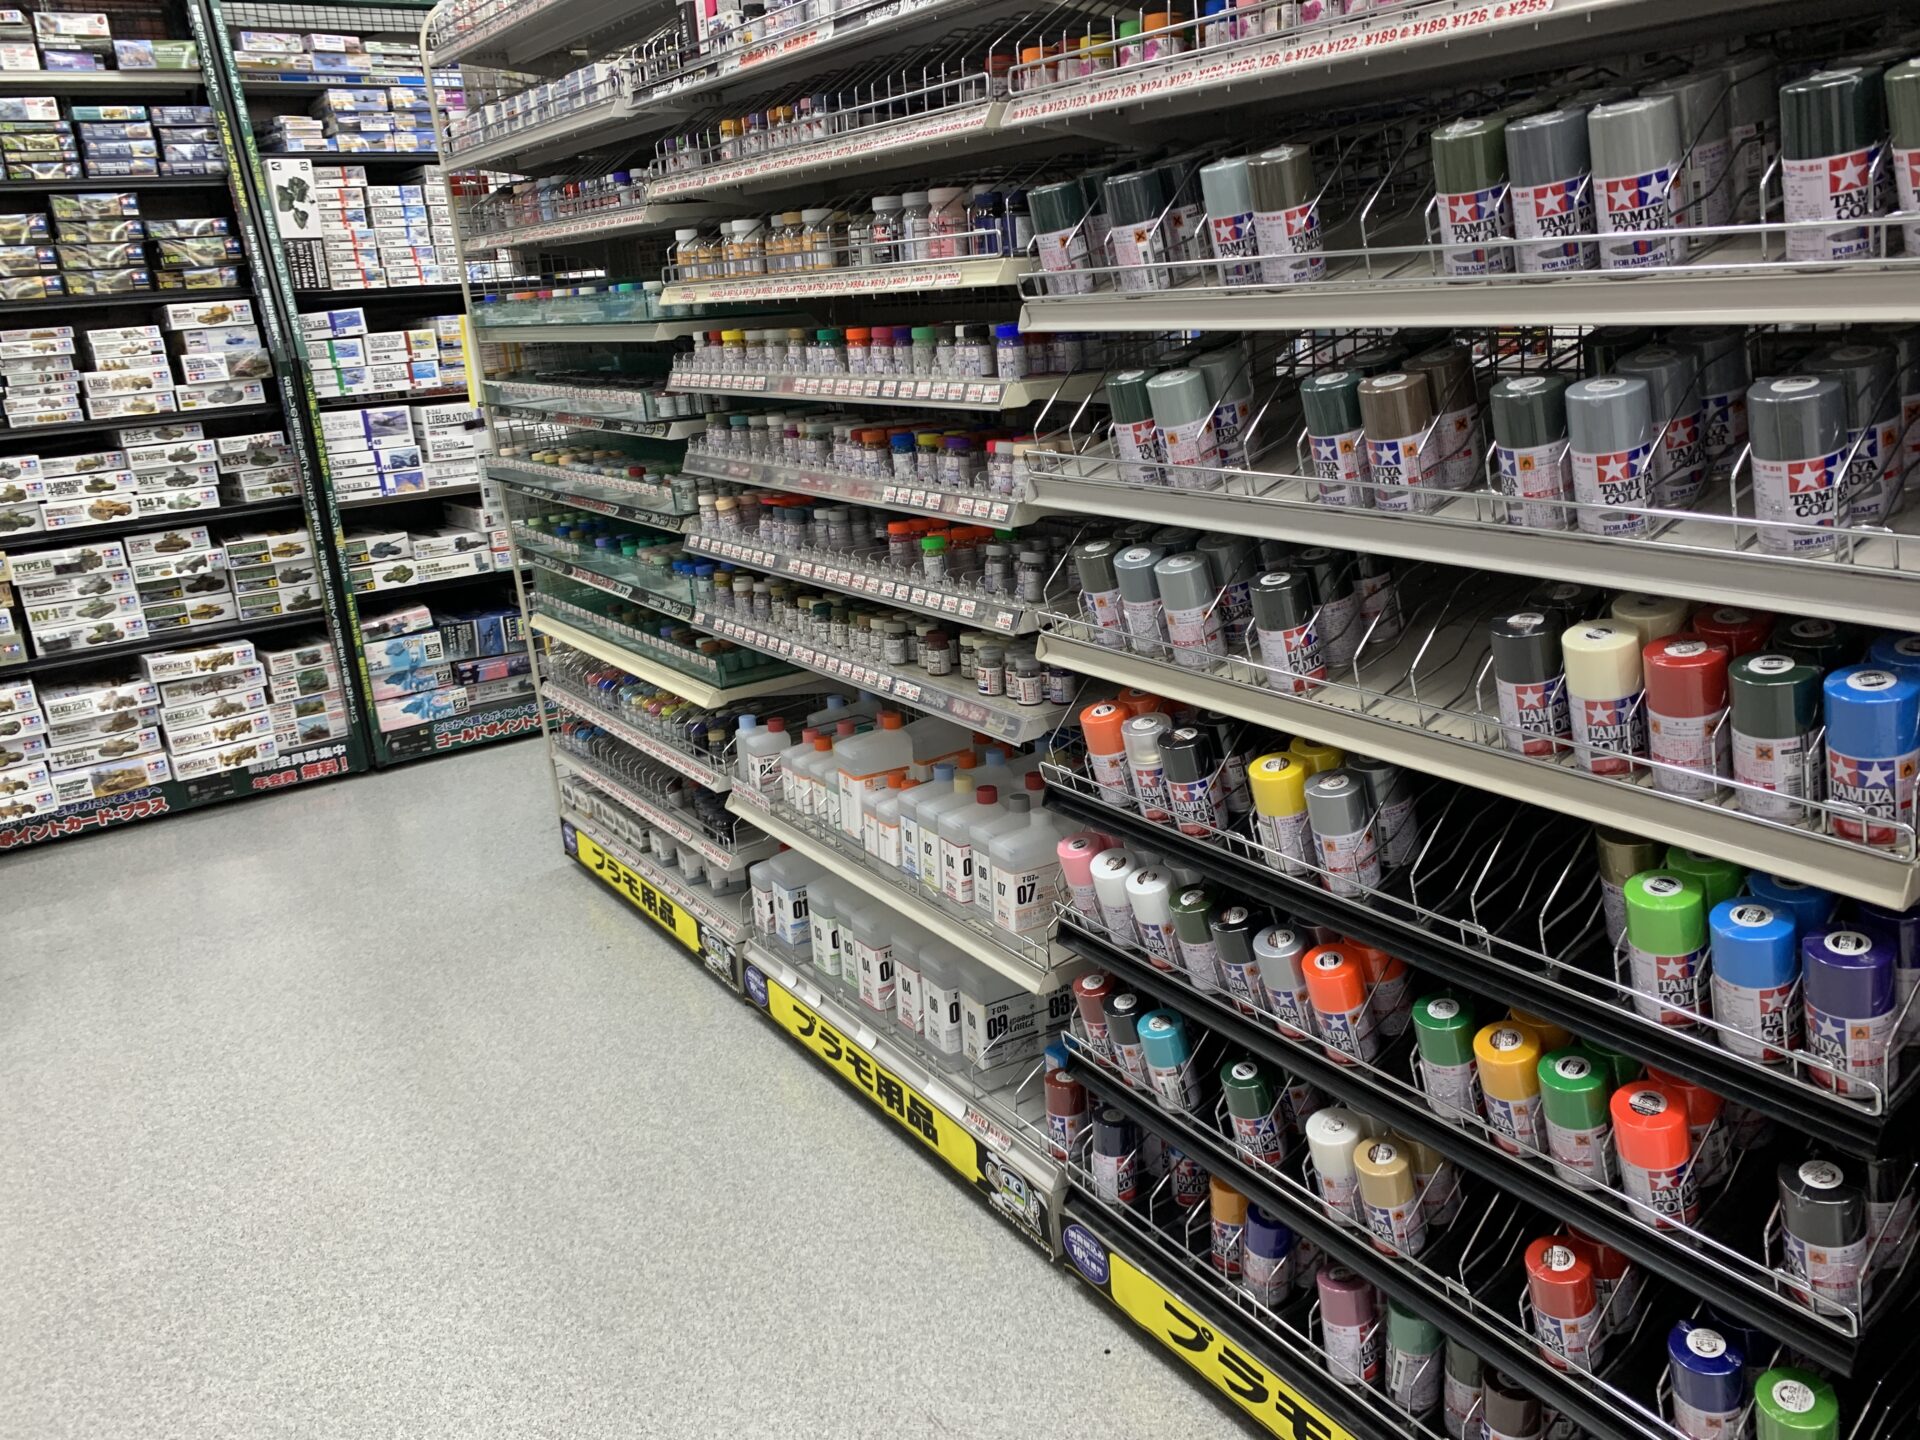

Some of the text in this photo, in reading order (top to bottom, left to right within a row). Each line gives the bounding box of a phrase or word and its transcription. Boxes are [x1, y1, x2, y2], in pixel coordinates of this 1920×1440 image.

[427, 411, 474, 424] LIBERATOR
[222, 455, 248, 467] R35
[330, 458, 357, 466] ANKER
[336, 482, 363, 491] ANKER
[13, 559, 52, 572] TYPE 16
[30, 608, 59, 623] KV-1
[440, 675, 453, 683] 27
[455, 700, 466, 709] 27
[252, 769, 298, 789] 年会費
[1831, 778, 1894, 804] TAMIYA
[905, 829, 913, 844] 01
[924, 843, 932, 856] 02
[946, 855, 955, 869] 04
[963, 858, 972, 876] 0
[978, 865, 987, 881] 06
[592, 848, 677, 932] プラモ用品
[997, 882, 1006, 896] 07
[1017, 883, 1036, 905] 07
[792, 899, 808, 919] 01
[844, 940, 853, 955] 03
[862, 957, 871, 974] 04
[902, 977, 911, 994] 04
[929, 996, 938, 1013] 06
[987, 1014, 1008, 1040] 09
[792, 1005, 940, 1147] プラモ用品
